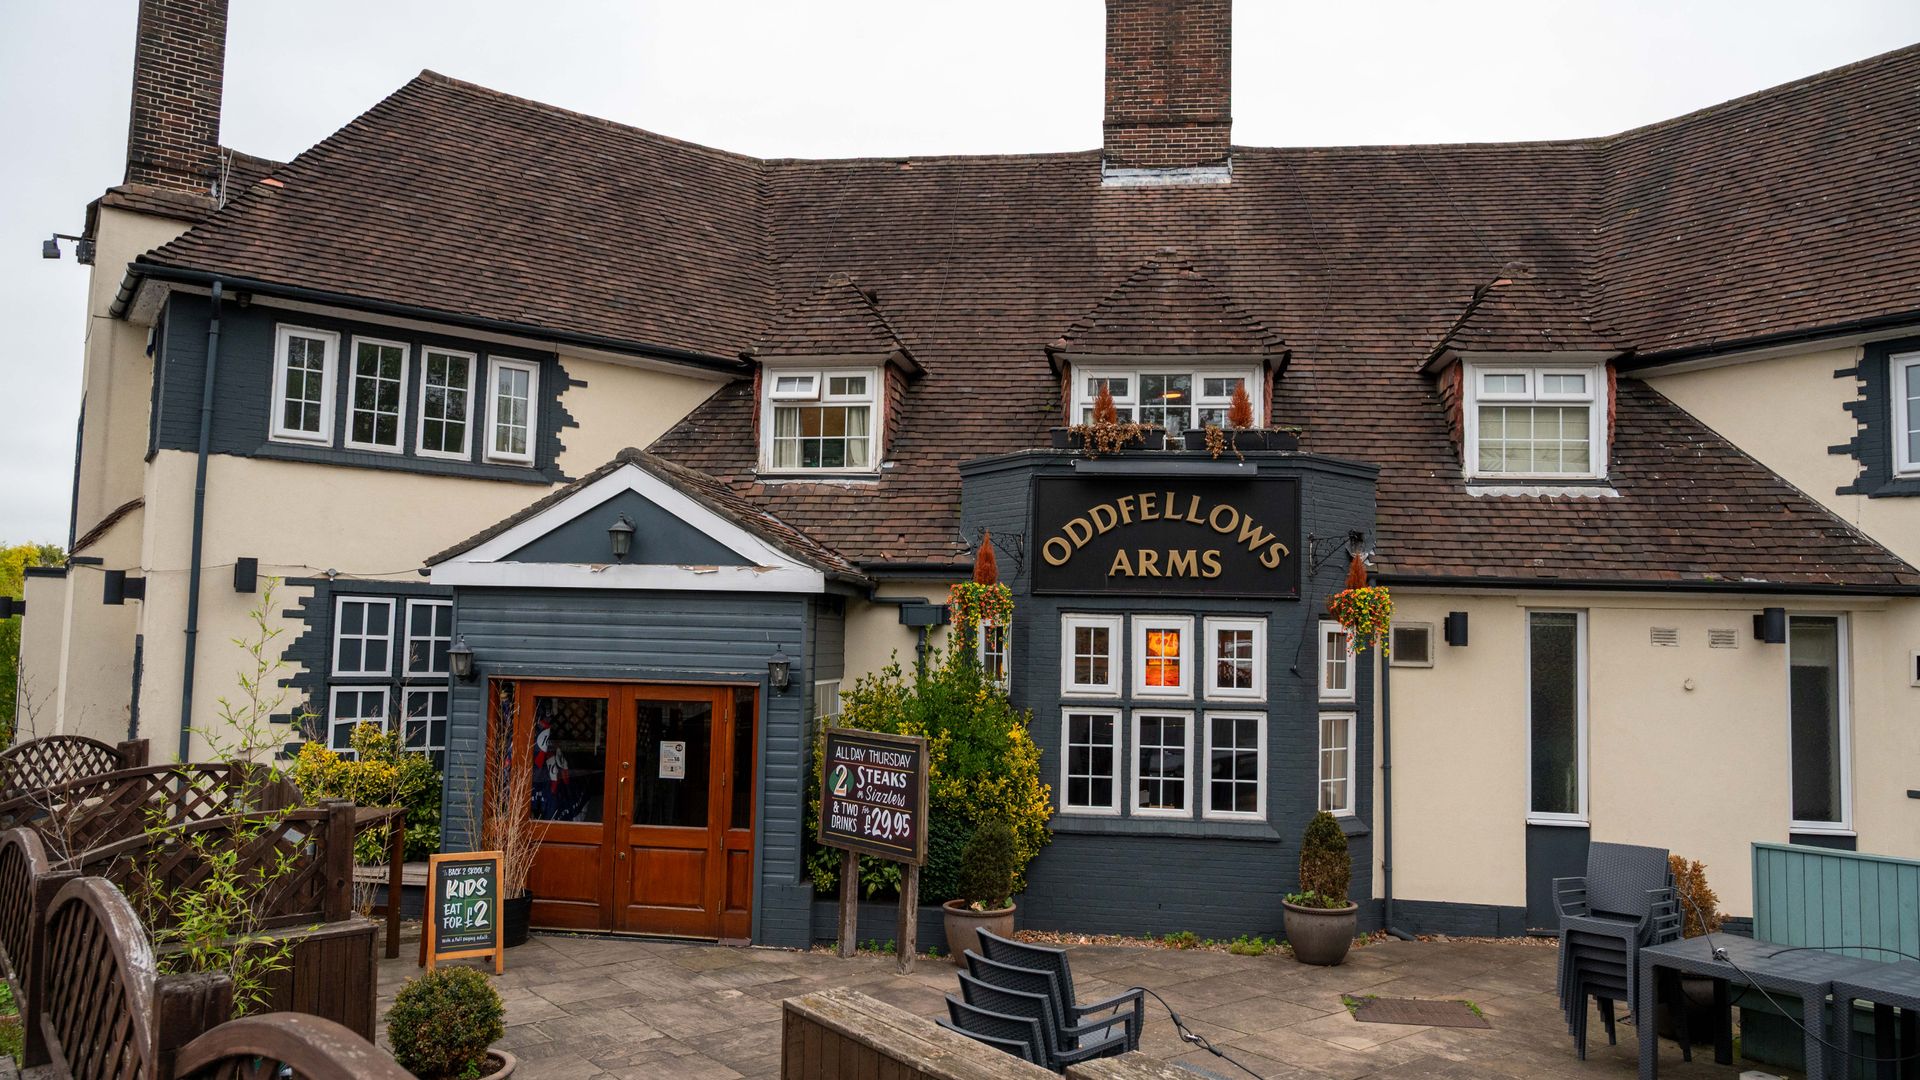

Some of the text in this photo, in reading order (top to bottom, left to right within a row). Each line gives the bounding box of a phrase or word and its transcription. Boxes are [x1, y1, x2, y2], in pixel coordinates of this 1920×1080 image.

[1042, 491, 1290, 569] ODDFELLOWS
[1108, 549, 1222, 578] ARMS
[835, 746, 911, 768] ALL DAY THURSDAY
[833, 764, 848, 797] 2
[856, 766, 907, 789] STEAKS
[865, 785, 906, 807] Sizzlers
[833, 801, 858, 816] & TWO
[831, 814, 857, 832] DRINKS
[864, 807, 911, 840] £29.95
[448, 868, 462, 876] BACK
[467, 866, 484, 875] SKOOL
[446, 877, 488, 899] KIDS
[444, 902, 462, 916] EAT
[465, 900, 489, 928] £2
[443, 916, 462, 929] FOR
